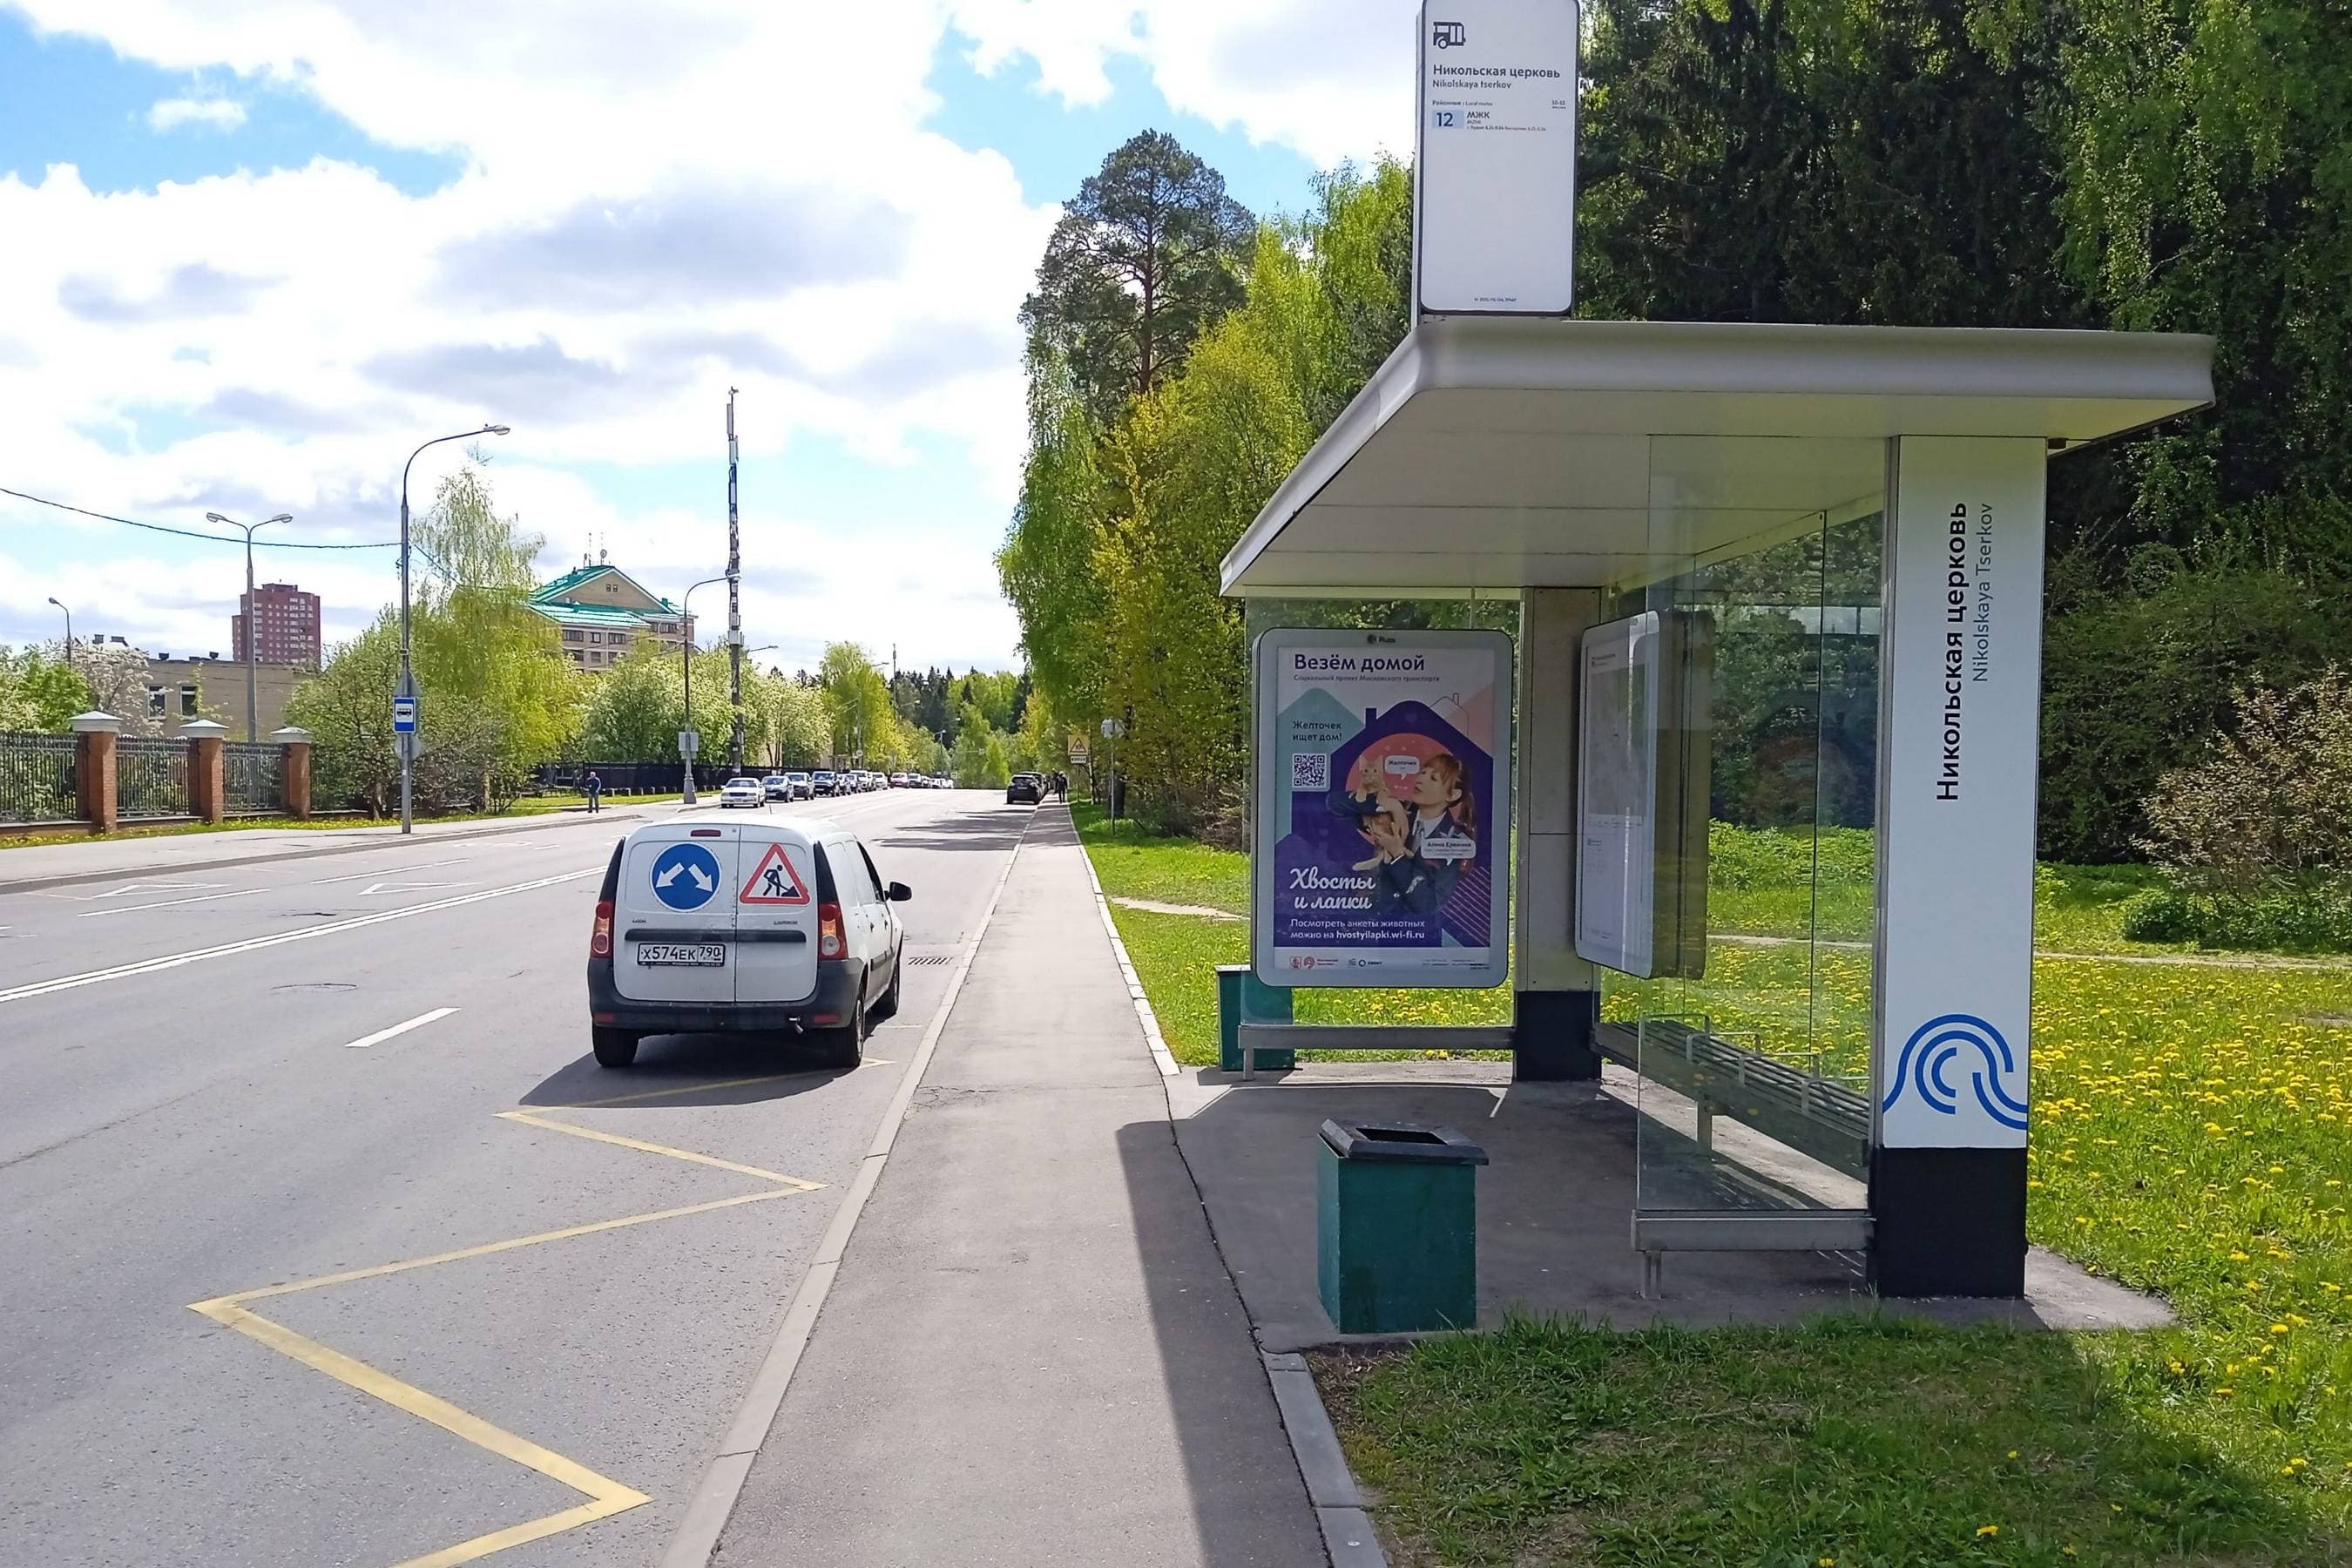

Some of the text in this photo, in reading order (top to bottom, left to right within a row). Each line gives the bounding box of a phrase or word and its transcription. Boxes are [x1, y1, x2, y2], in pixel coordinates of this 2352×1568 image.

[1433, 64, 1560, 79] Никольская церковь
[1432, 79, 1478, 90] Nikolskaya
[1436, 112, 1454, 127] 12
[1972, 503, 1994, 682] Nikolskaya Tserkov
[1936, 502, 1970, 801] Никольская церковь
[1294, 654, 1424, 672] Везём домой
[1293, 720, 1342, 729] Желточек
[1319, 733, 1342, 741] дом!
[1289, 866, 1375, 890] Хвосты
[1294, 896, 1373, 910] и лапки
[1290, 919, 1345, 929] Посмотреть
[1336, 930, 1425, 941] hvostyilapki.wi-fi.ru
